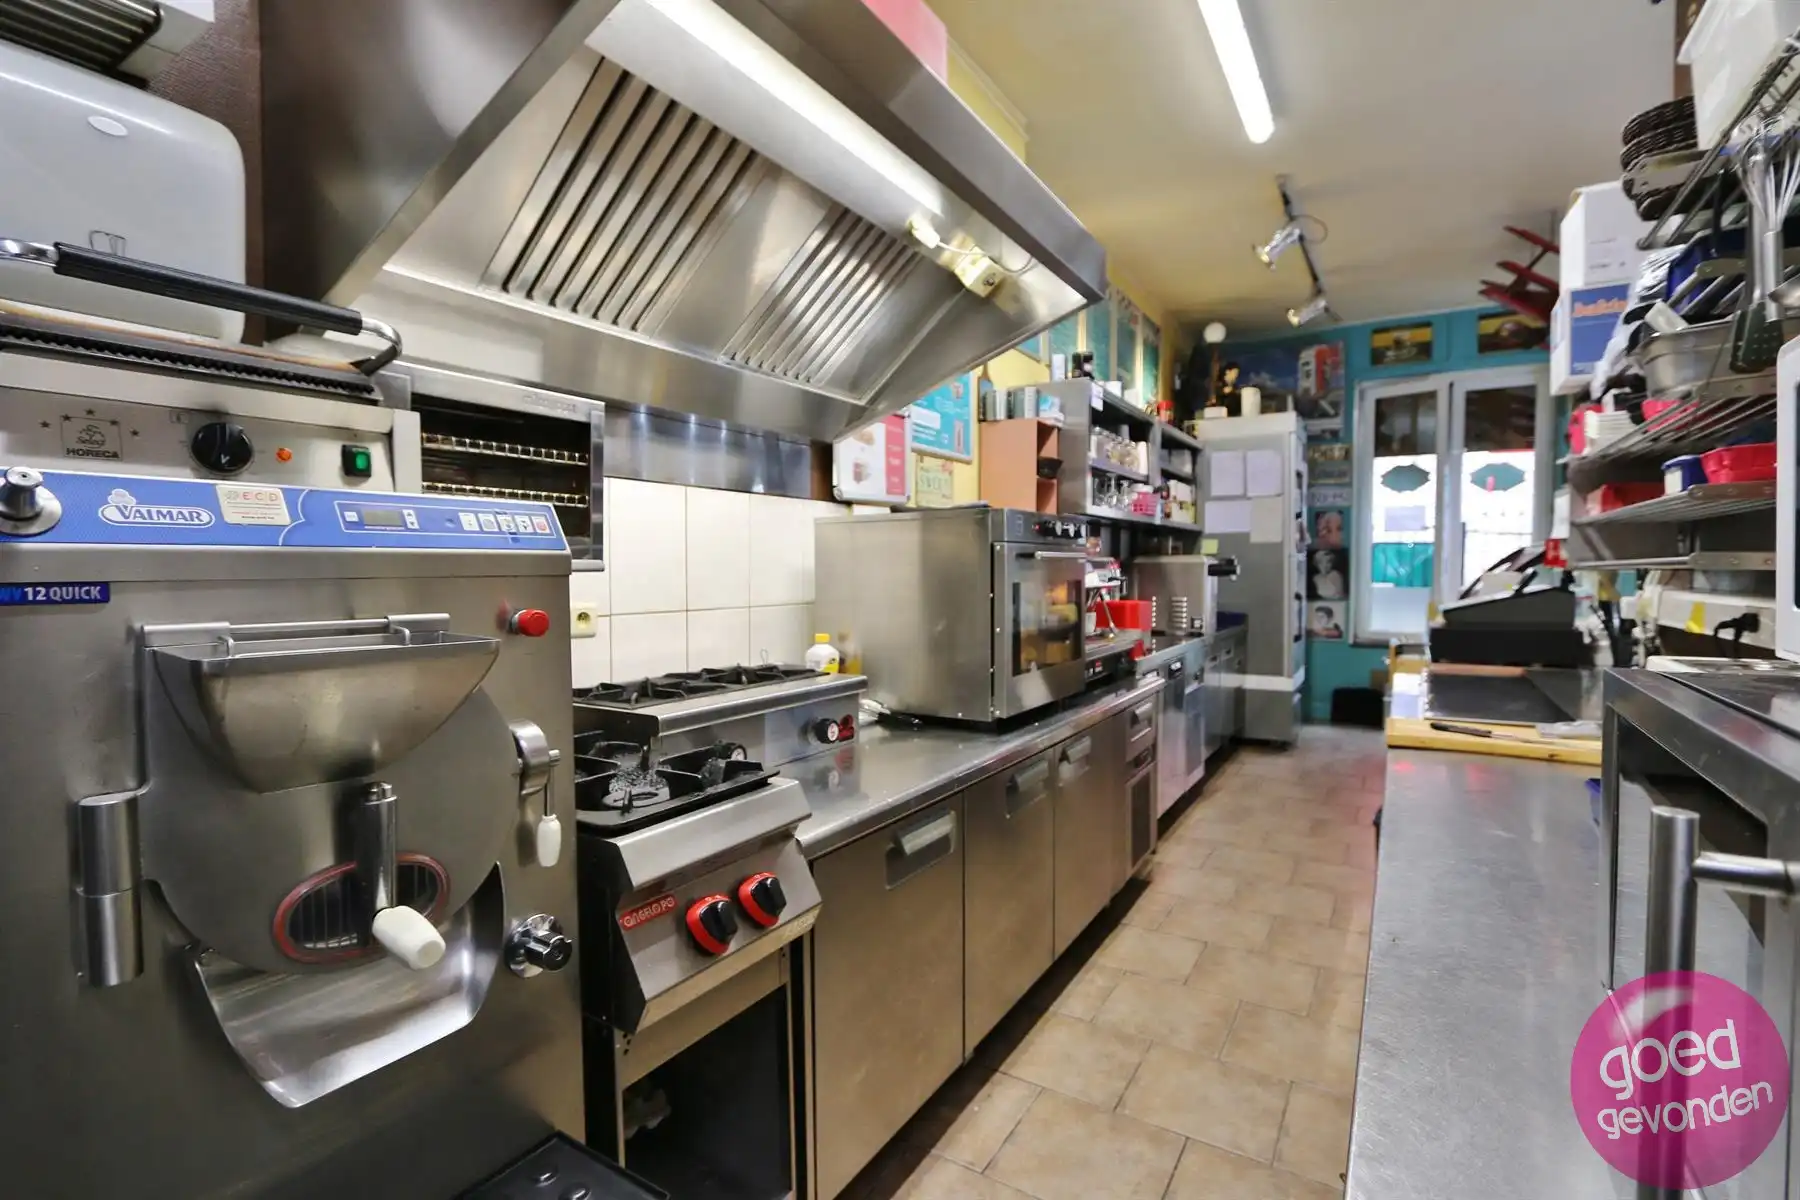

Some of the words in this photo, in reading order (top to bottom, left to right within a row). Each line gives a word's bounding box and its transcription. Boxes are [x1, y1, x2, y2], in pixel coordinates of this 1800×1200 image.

[66, 447, 120, 459] HORECA
[115, 504, 204, 523] VALMAR
[23, 586, 47, 601] 12
[49, 585, 102, 602] QUICK
